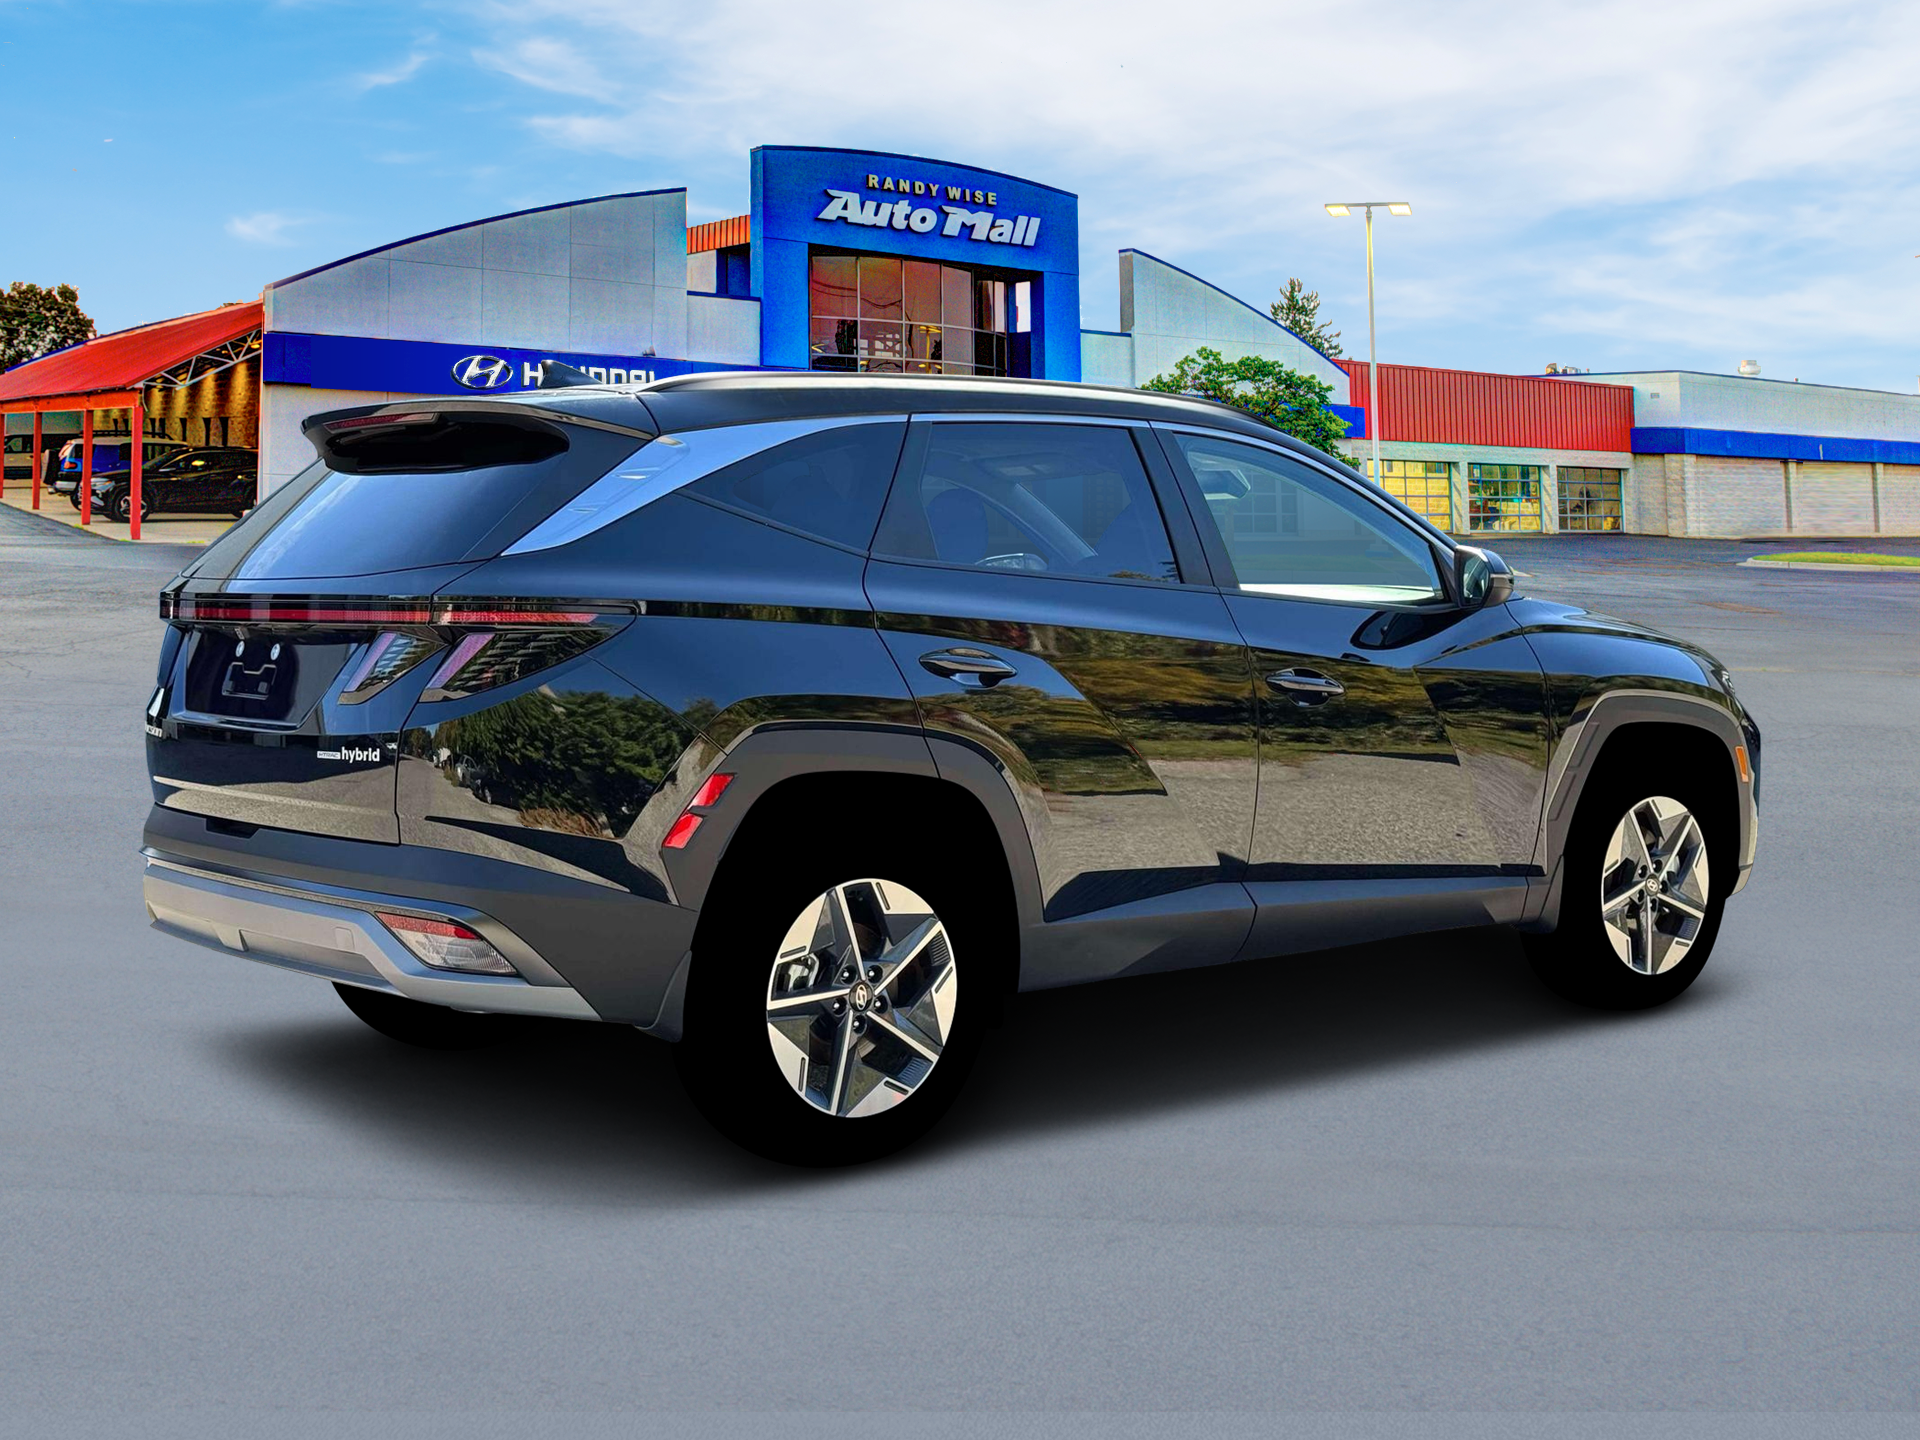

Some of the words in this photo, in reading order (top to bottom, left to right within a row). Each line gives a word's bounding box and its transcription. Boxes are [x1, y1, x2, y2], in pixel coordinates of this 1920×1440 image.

[867, 174, 939, 197] RANDY
[946, 186, 998, 206] WISE
[817, 188, 938, 233] Auto
[941, 205, 1041, 247] Mall
[523, 361, 655, 386] HNDAI
[341, 746, 380, 763] hybrid
